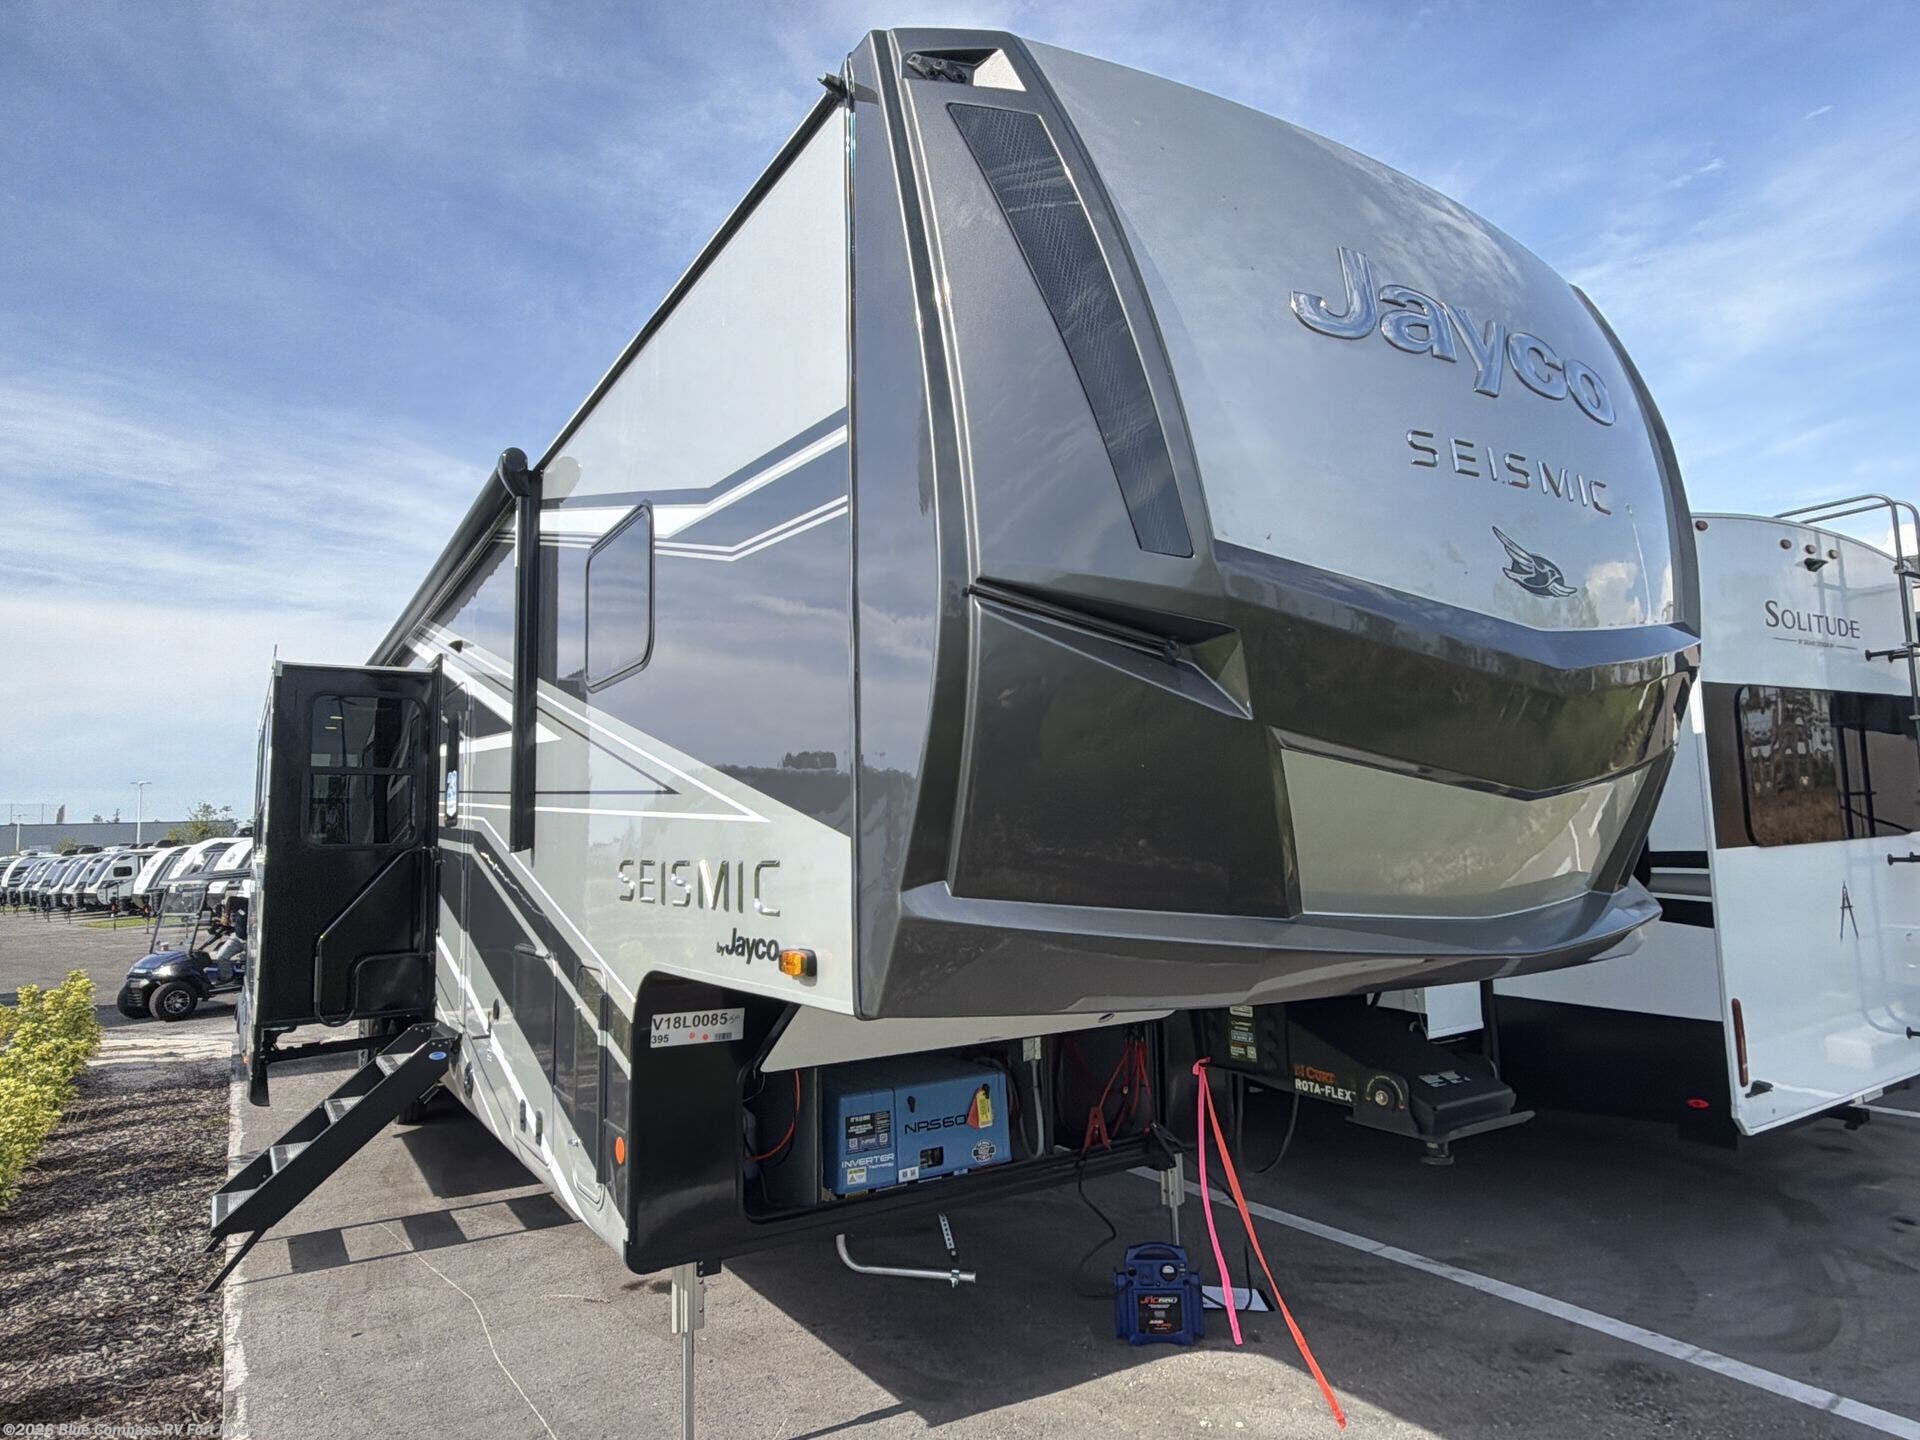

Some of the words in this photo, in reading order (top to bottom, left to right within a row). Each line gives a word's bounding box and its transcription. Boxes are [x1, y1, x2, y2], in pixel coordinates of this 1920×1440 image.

[1290, 247, 1616, 426] Jayco
[1406, 429, 1612, 515] SEISMIC
[1765, 600, 1861, 639] SOLITUDE
[617, 859, 781, 917] SEISMIC
[717, 941, 726, 957] by
[726, 928, 779, 964] Jayco
[651, 1034, 669, 1044] 395
[652, 1013, 728, 1030] V18L0085
[841, 1153, 895, 1168] INVERTER
